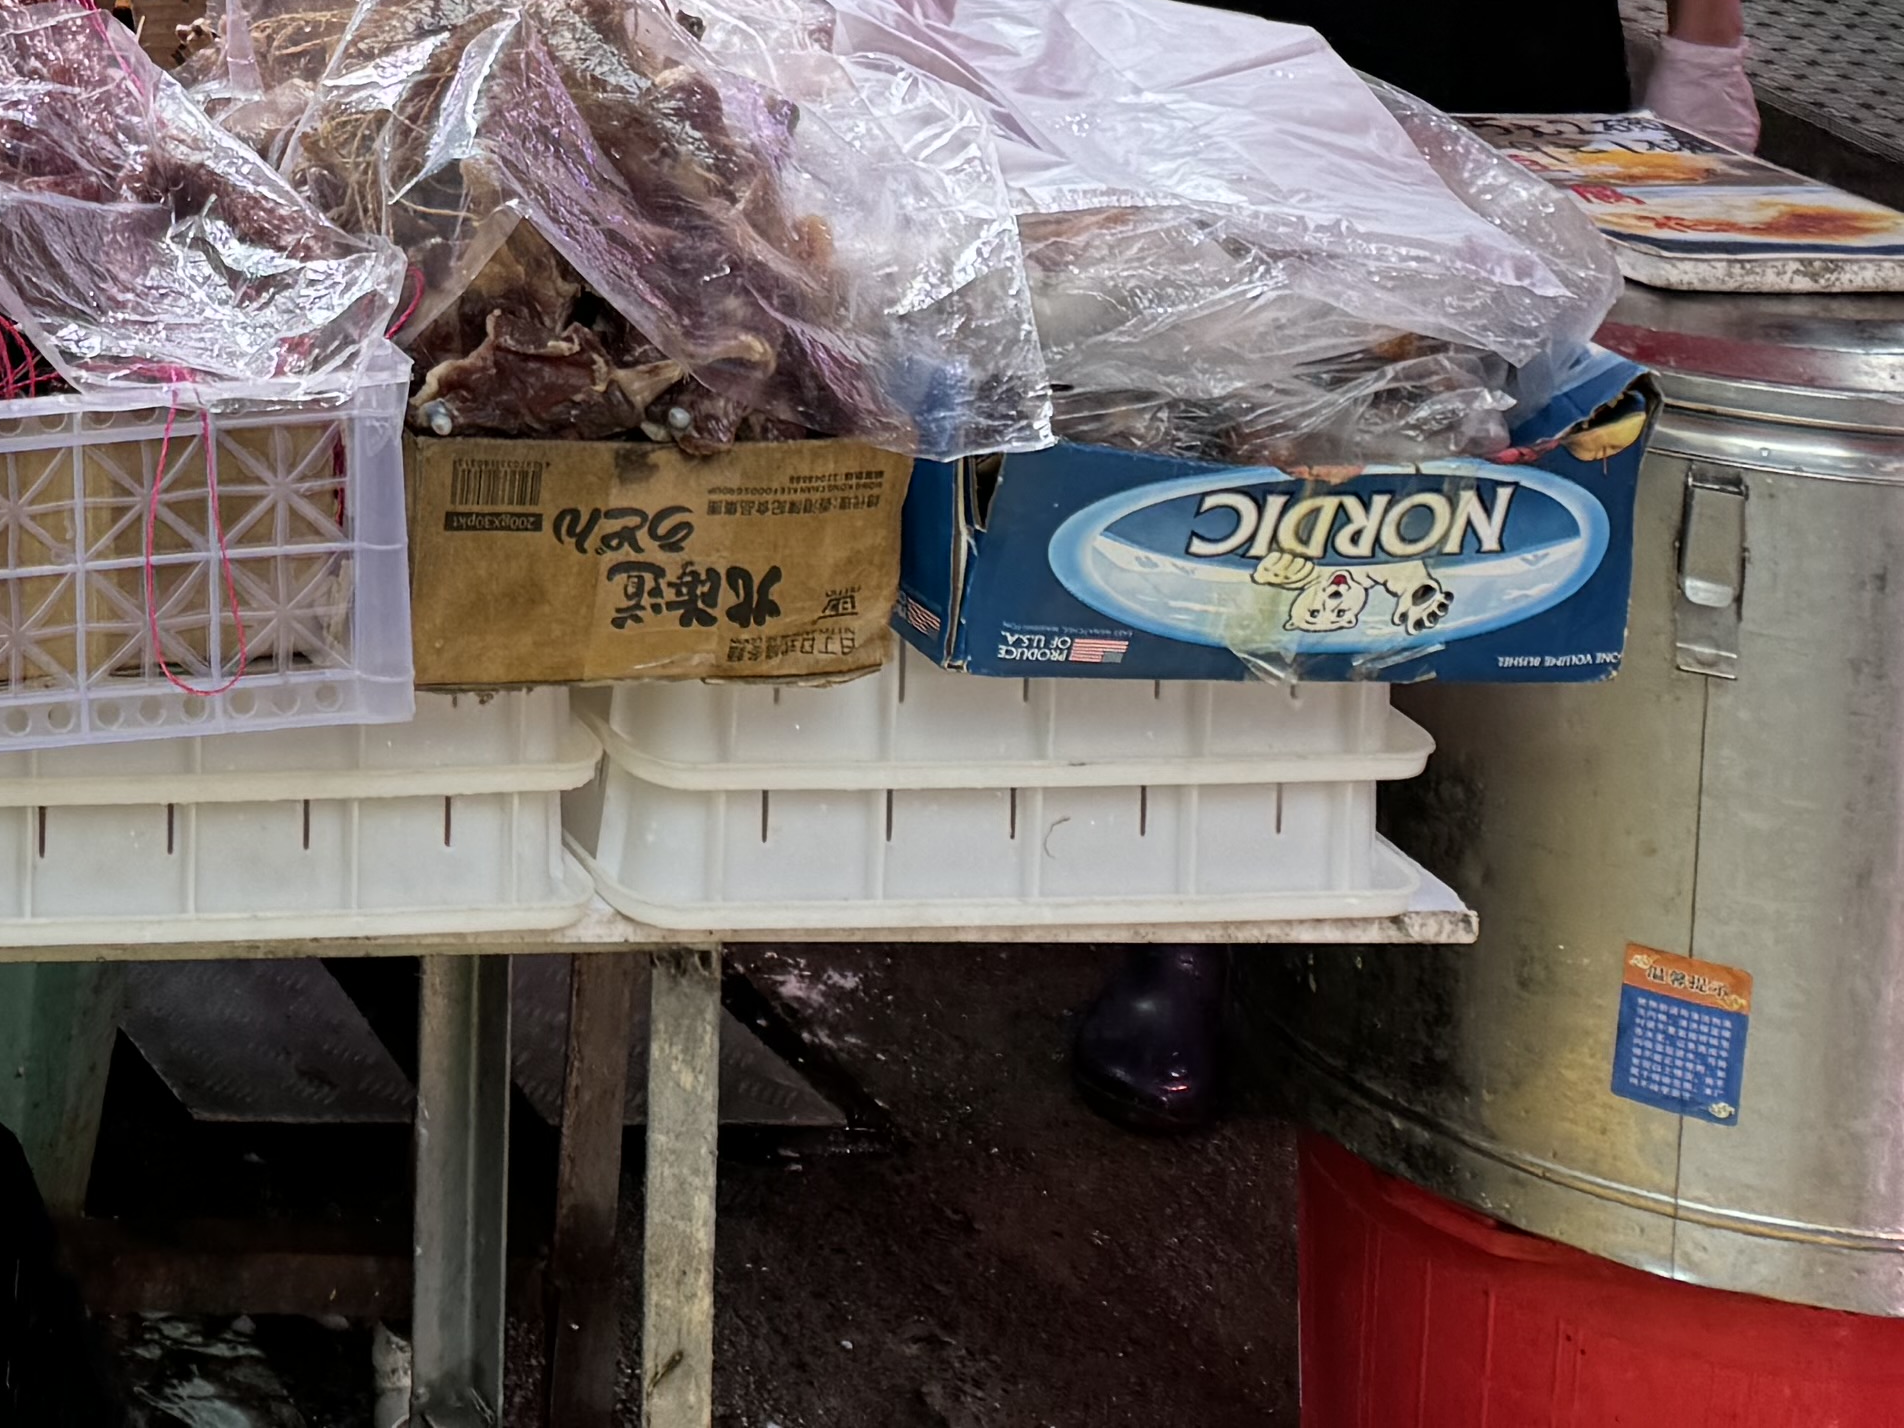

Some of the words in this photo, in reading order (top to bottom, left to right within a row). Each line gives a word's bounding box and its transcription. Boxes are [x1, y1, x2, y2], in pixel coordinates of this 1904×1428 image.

[552, 506, 695, 555] うどん
[1186, 482, 1517, 560] NORDIC
[607, 561, 783, 630] 北海道
[997, 645, 1068, 662] PRODUCE
[1049, 636, 1072, 649] OF
